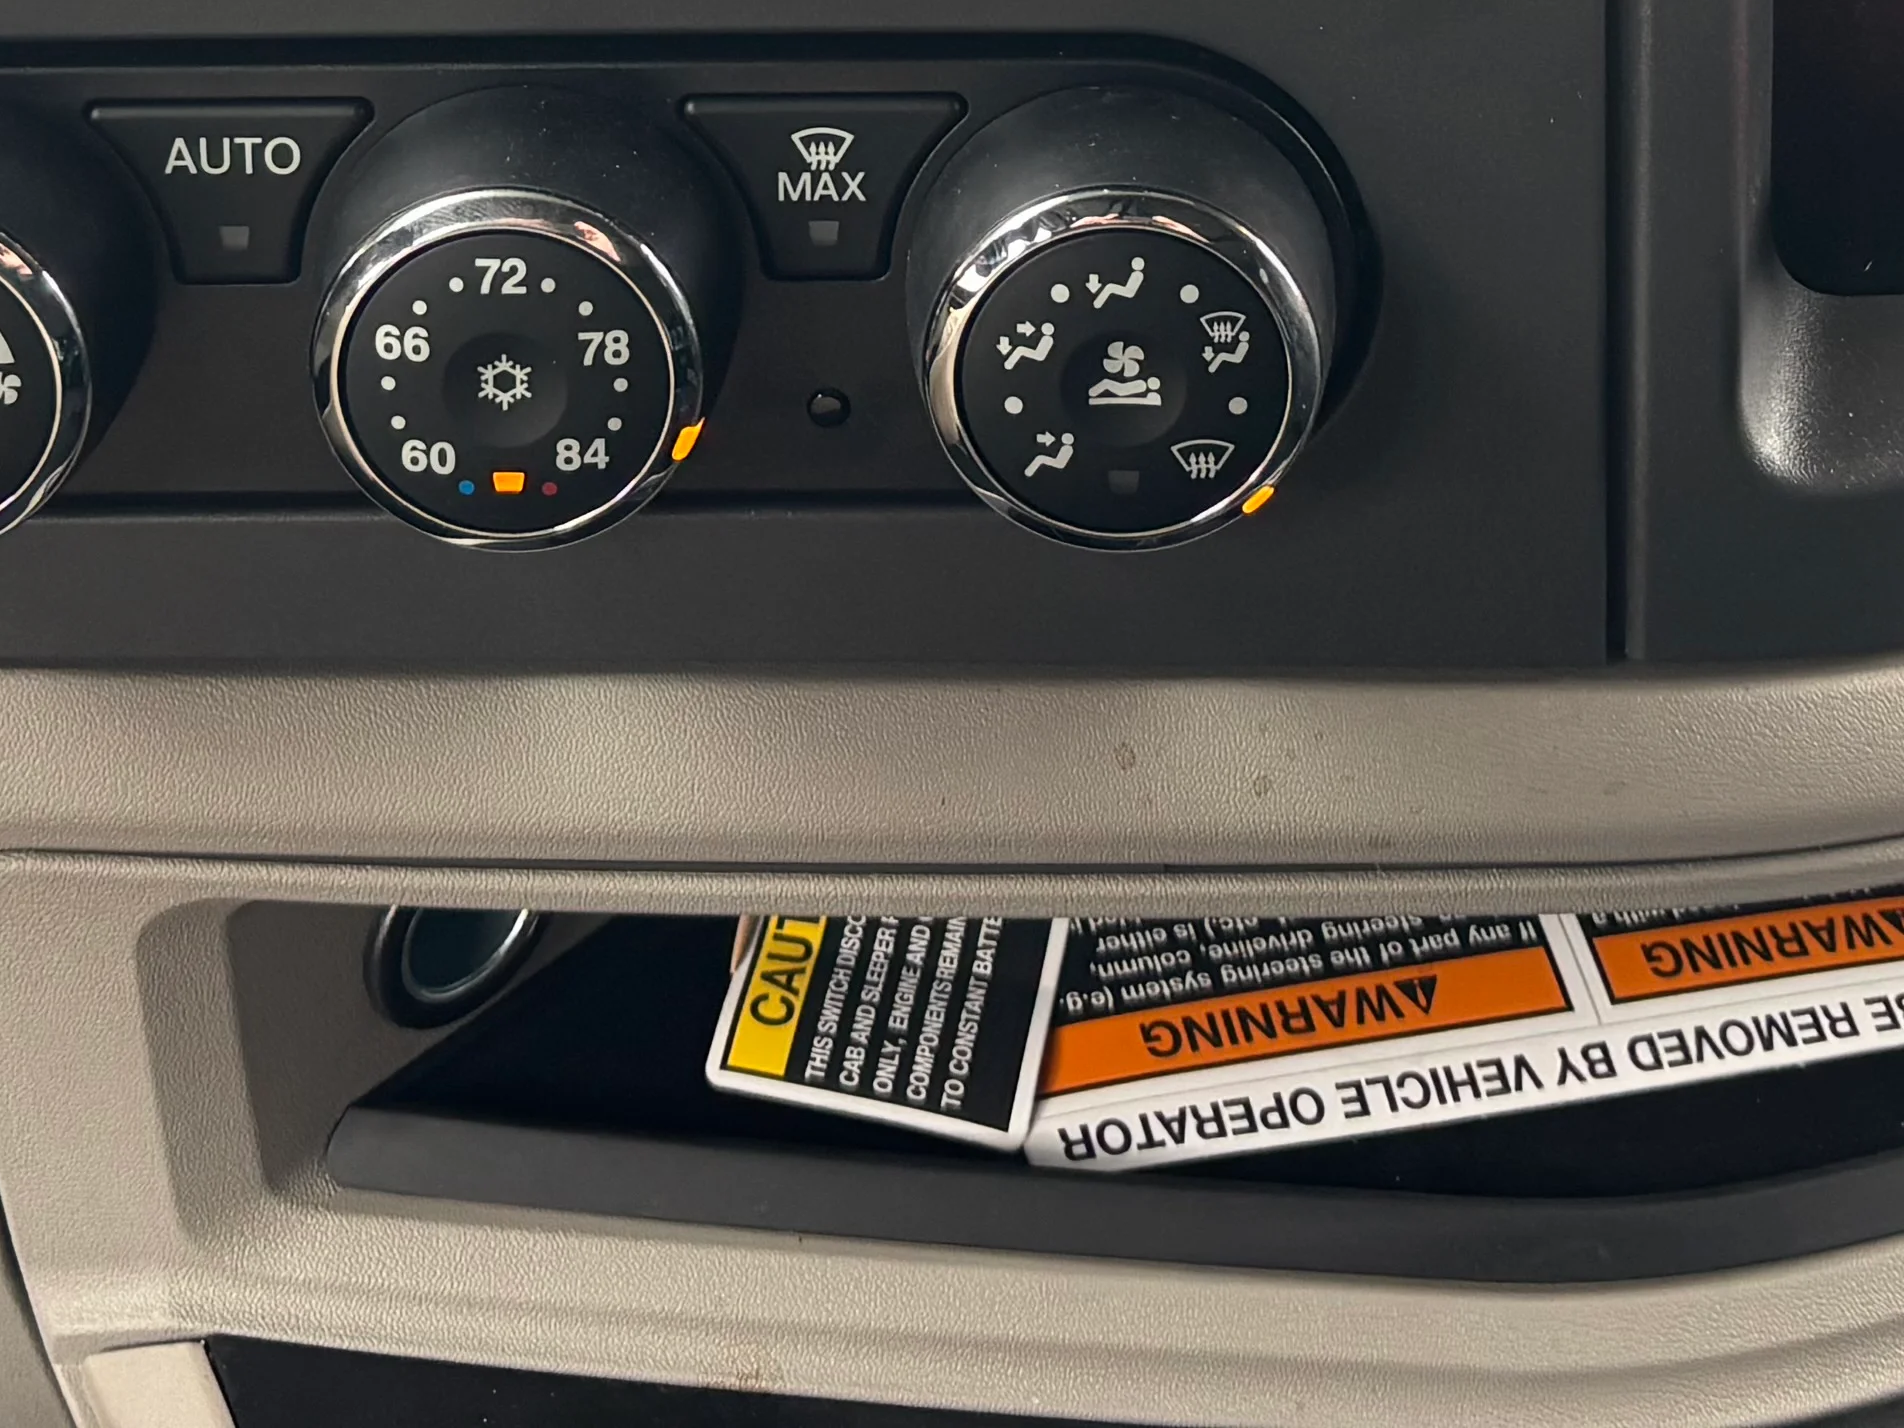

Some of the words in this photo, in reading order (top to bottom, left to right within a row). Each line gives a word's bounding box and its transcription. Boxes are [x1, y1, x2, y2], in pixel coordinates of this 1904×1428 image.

[164, 136, 302, 176] AUTO
[777, 170, 868, 203] MAX
[474, 257, 528, 296] 72
[374, 325, 431, 363] 66
[577, 330, 631, 367] 78
[400, 440, 457, 475] 60
[555, 437, 610, 472] 84
[907, 924, 931, 966] AND
[1097, 926, 1167, 954] either
[1173, 922, 1196, 941] is
[1409, 928, 1459, 957] part
[1468, 923, 1511, 944] any
[1641, 912, 1895, 980] WARNING
[861, 926, 897, 1004] SLEEPER
[1090, 949, 1191, 981] column,
[1220, 951, 1323, 985] steering
[1330, 946, 1372, 968] the
[1379, 940, 1403, 964] of
[818, 966, 852, 1035] SWITCH
[889, 966, 921, 1031] ENGINE
[1121, 971, 1211, 1002] system
[852, 1003, 876, 1044] AND
[949, 976, 989, 1076] CONSTANT
[1139, 982, 1405, 1058] WARNING
[1627, 1002, 1861, 1072] REMOVED
[805, 1036, 833, 1081] THIS
[907, 981, 952, 1100] COMPONENTS
[840, 1046, 865, 1088] CAB
[873, 1039, 907, 1094] ONLY,
[1557, 1040, 1618, 1086] BY
[940, 1078, 965, 1111] TO
[1335, 1054, 1545, 1120] VEHICLE
[1058, 1086, 1325, 1163] OPERATOR
